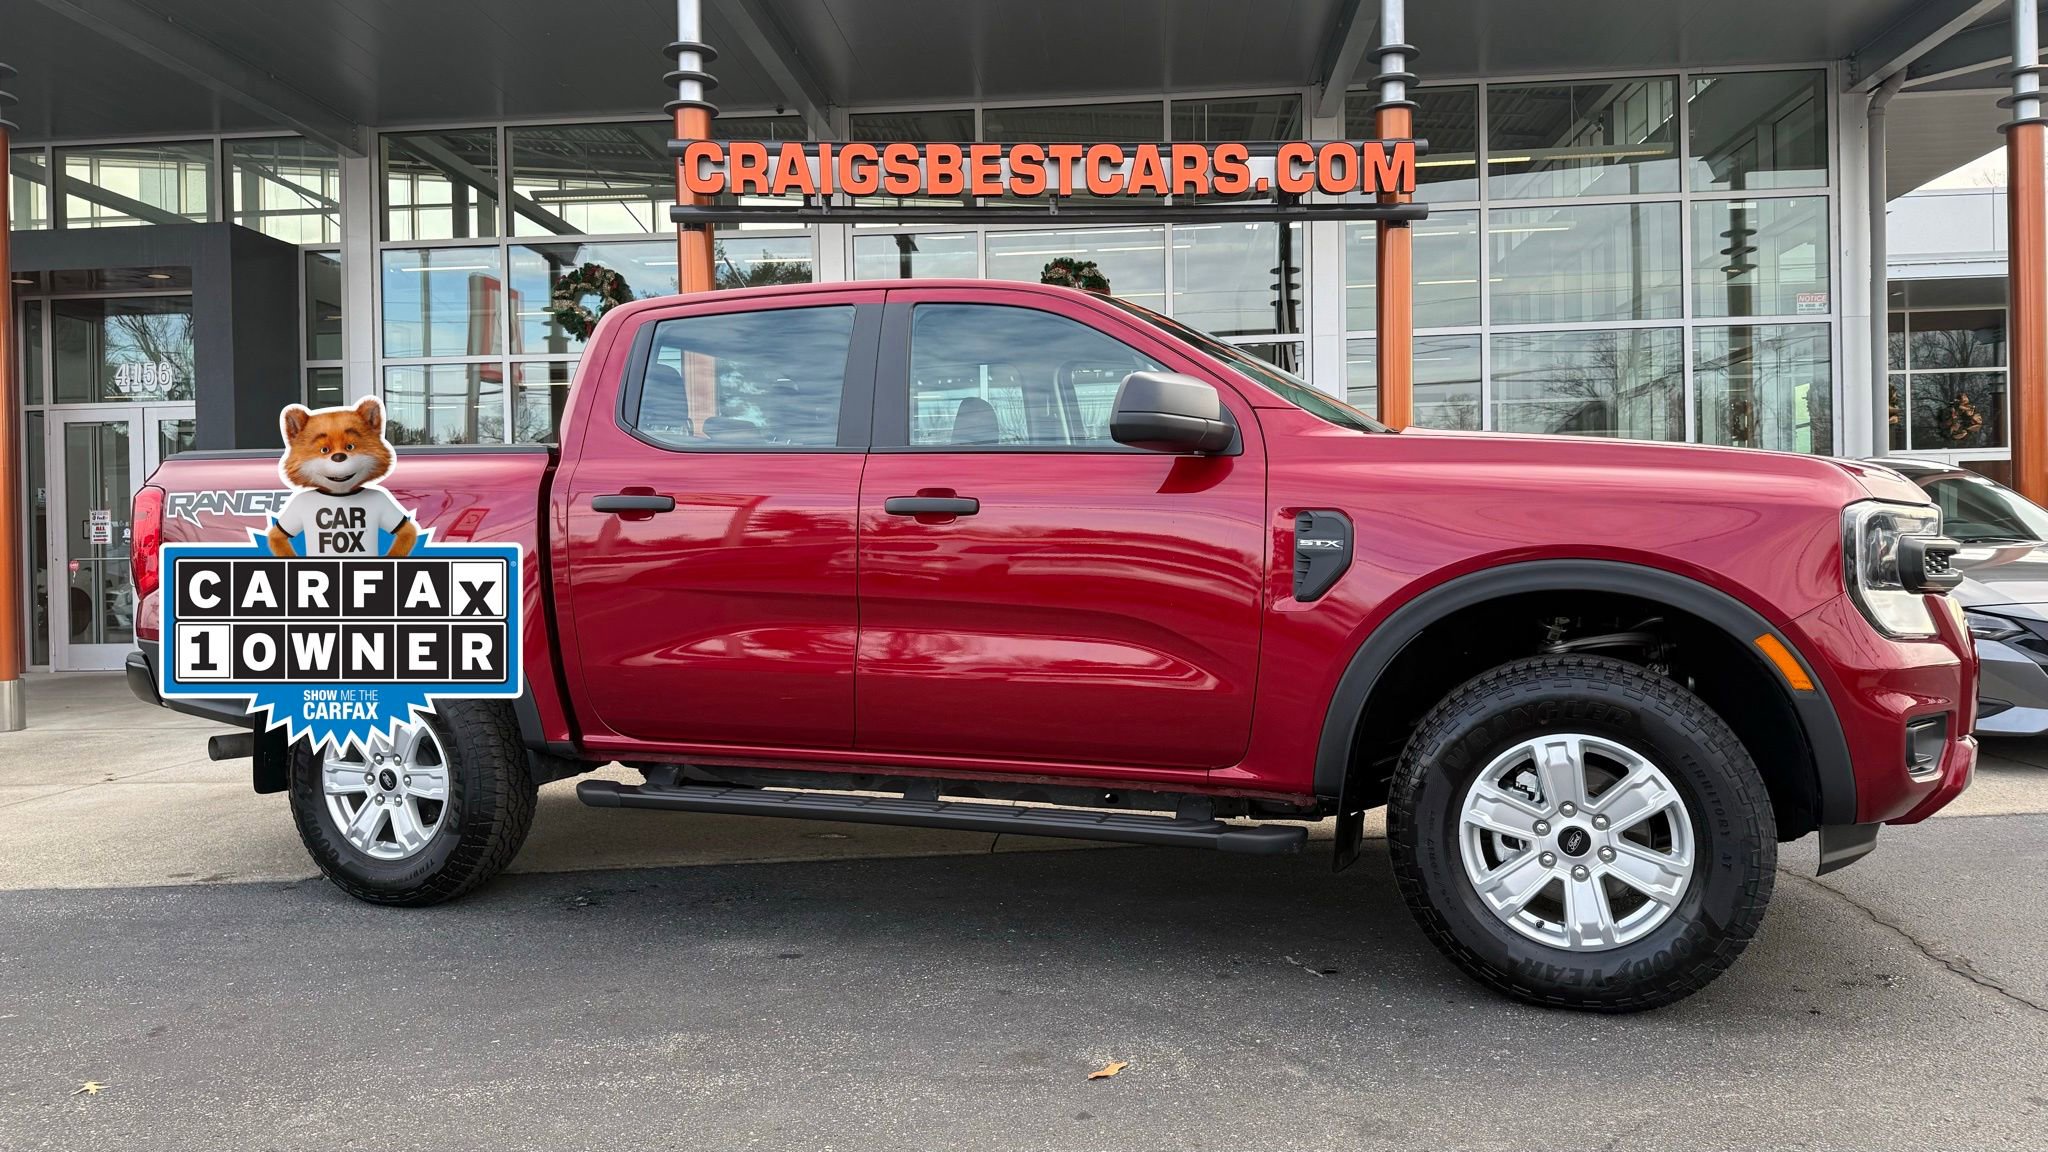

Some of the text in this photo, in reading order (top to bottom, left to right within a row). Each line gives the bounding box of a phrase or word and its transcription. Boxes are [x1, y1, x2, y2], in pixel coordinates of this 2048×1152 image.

[684, 140, 1416, 197] CRAIGSBESTCARS.COM
[115, 361, 172, 391] 4156
[167, 489, 293, 529] RANGE
[1299, 539, 1341, 548] STX
